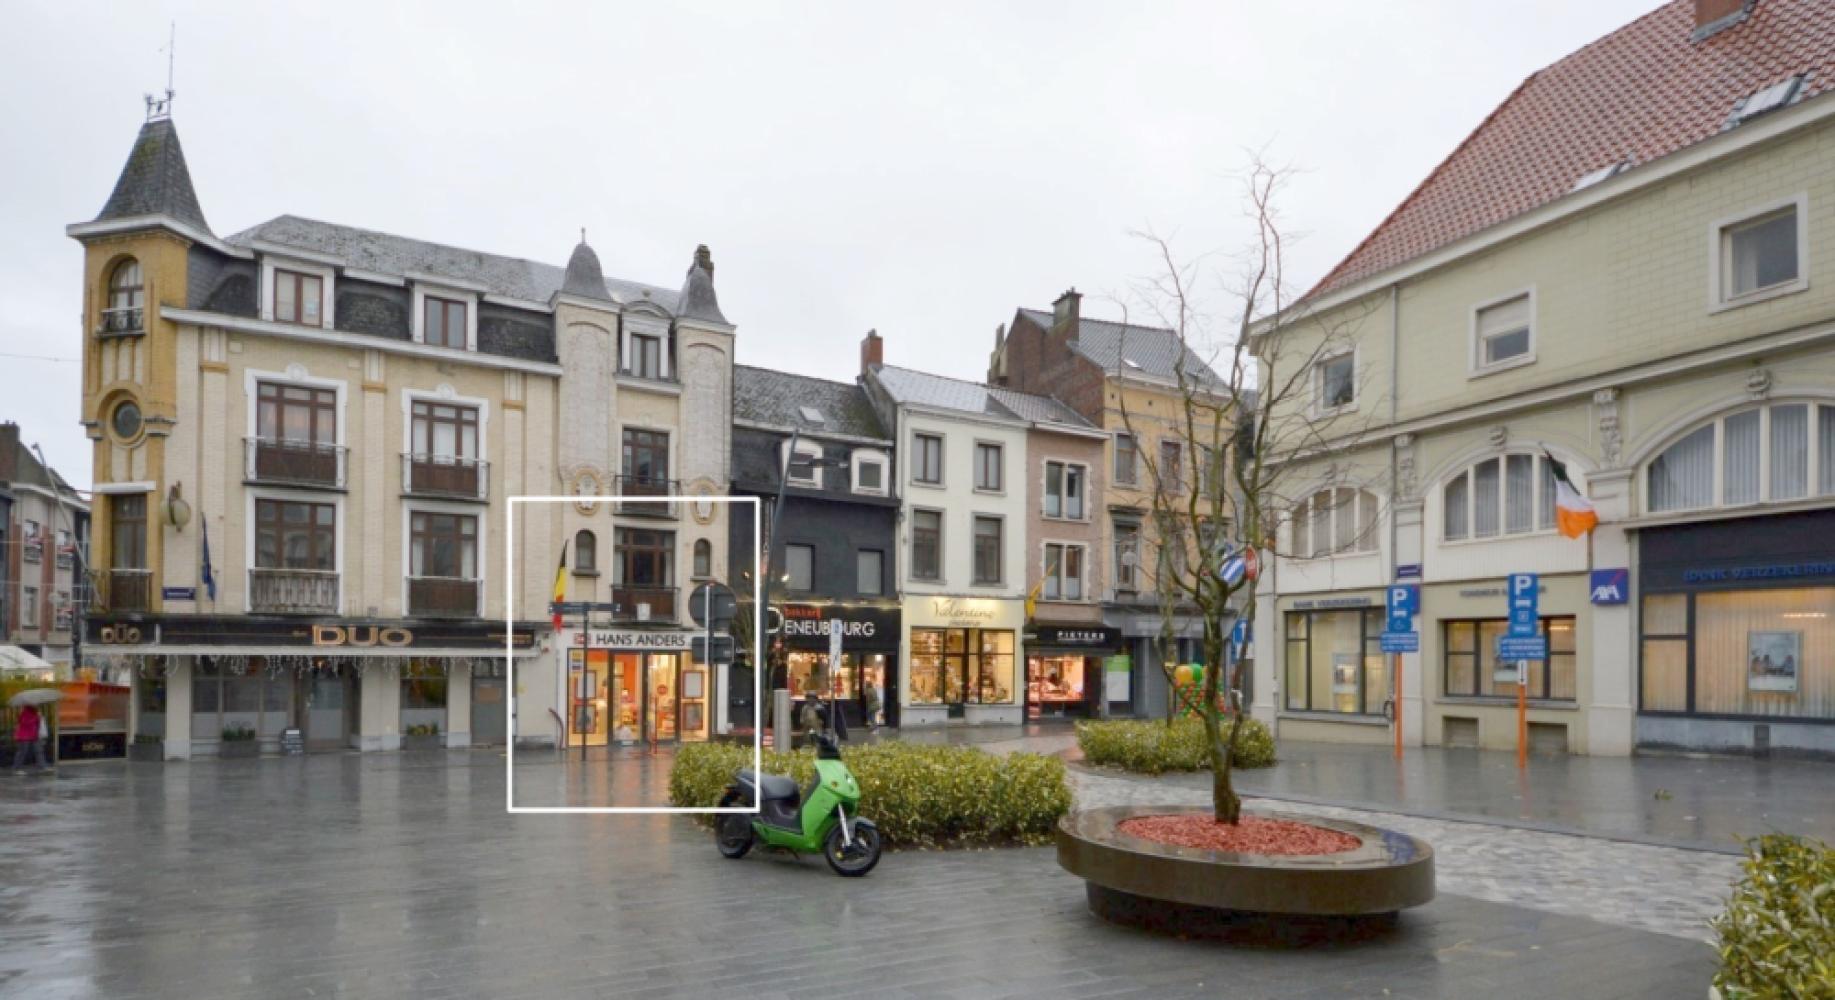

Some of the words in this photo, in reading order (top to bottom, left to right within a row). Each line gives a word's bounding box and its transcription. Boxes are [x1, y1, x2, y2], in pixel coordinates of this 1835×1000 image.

[1514, 575, 1532, 595] P
[1591, 585, 1621, 601] AXA
[1392, 588, 1408, 607] P
[765, 606, 876, 637] DENEUBURG
[596, 634, 632, 646] HANS
[636, 634, 686, 647] ANDERS
